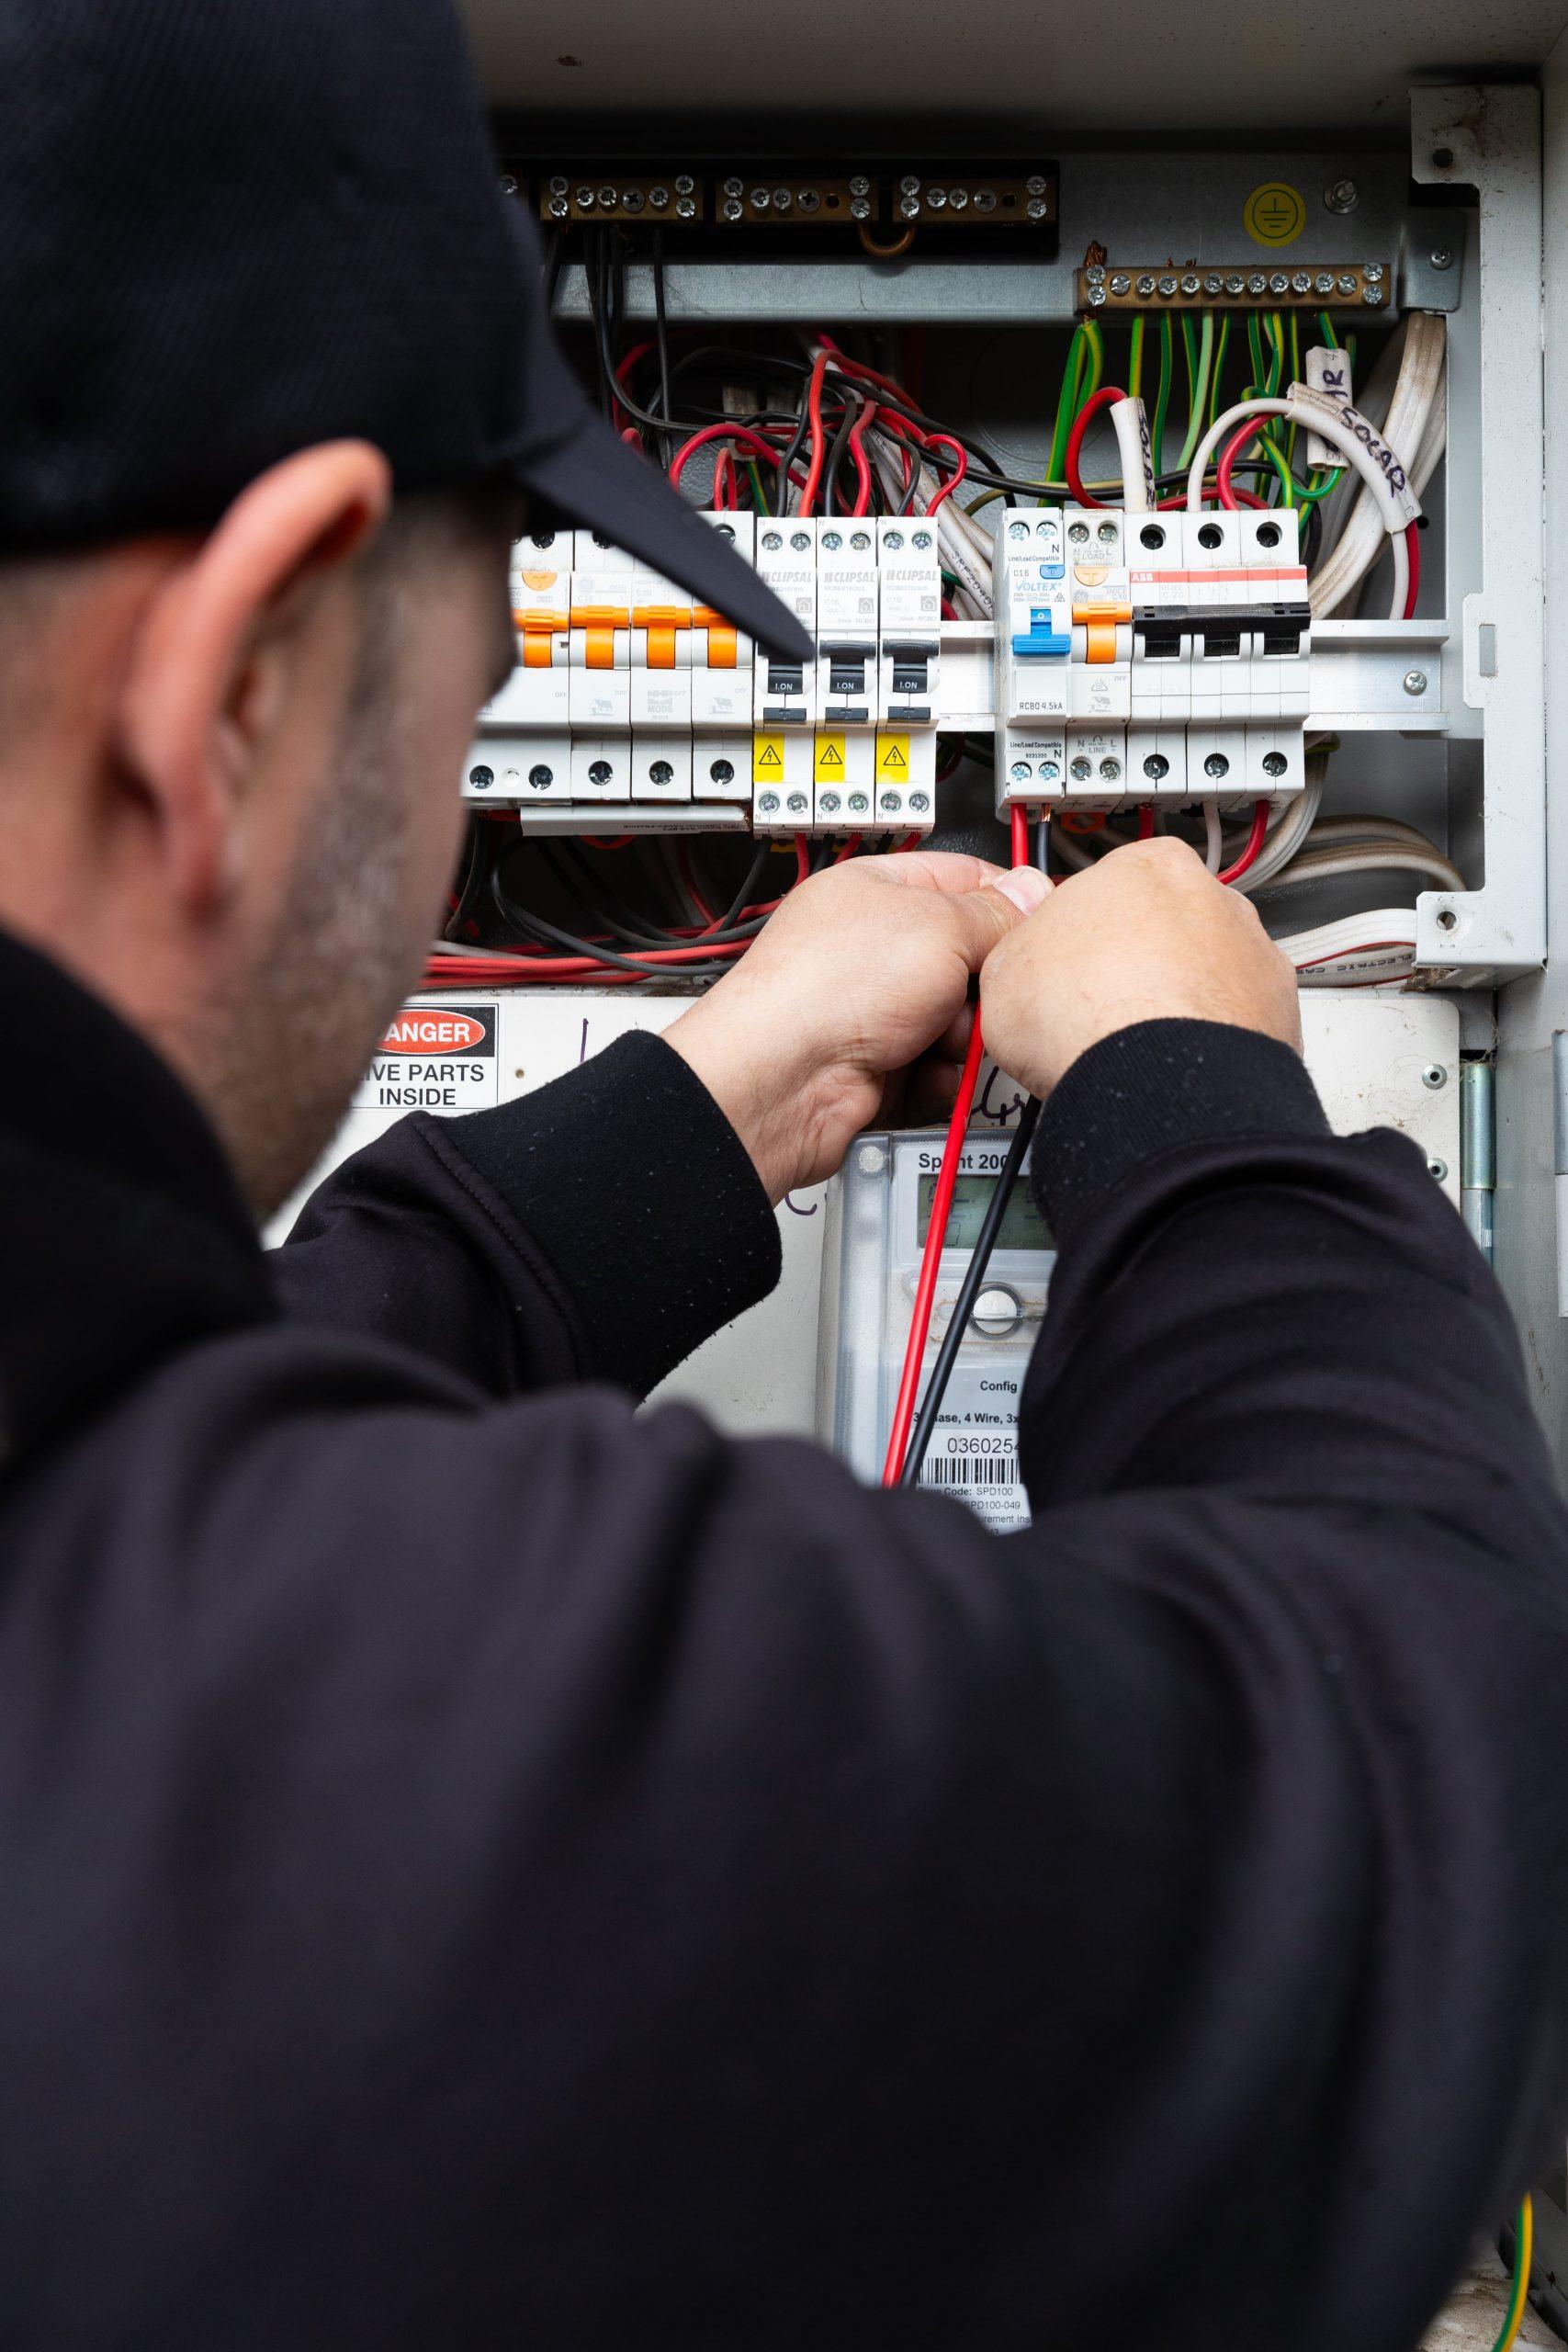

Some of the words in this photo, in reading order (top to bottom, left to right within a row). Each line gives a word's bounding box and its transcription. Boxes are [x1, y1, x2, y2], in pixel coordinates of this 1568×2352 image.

[1338, 406, 1406, 498] SOLAR
[1052, 544, 1060, 553] N
[1082, 552, 1105, 560] LOAD
[770, 571, 813, 583] CLIPSAL
[833, 571, 875, 582] CLIPSAL
[895, 570, 938, 582] CLIPSAL
[952, 549, 992, 607] SRF2040
[1013, 569, 1030, 577] C16
[1131, 573, 1154, 582] ABB
[1019, 702, 1040, 710] RCBO
[1042, 702, 1063, 710] 4.5kA
[1034, 741, 1062, 750] Compatible
[1077, 740, 1085, 748] N
[1054, 749, 1062, 759] N
[1337, 954, 1413, 971] ELECTRIC
[383, 1021, 471, 1044] ANGER
[366, 1063, 401, 1082] IVE
[408, 1063, 485, 1082] PARTS
[379, 1088, 457, 1106] INSIDE
[918, 1152, 974, 1172] Spnt
[979, 1380, 1018, 1395] Config
[964, 1413, 972, 1423] 4
[975, 1413, 1003, 1425] Wire,
[943, 1487, 973, 1496] Code:
[976, 1487, 1013, 1497] SPD100
[964, 1500, 1021, 1510] SPD100-049
